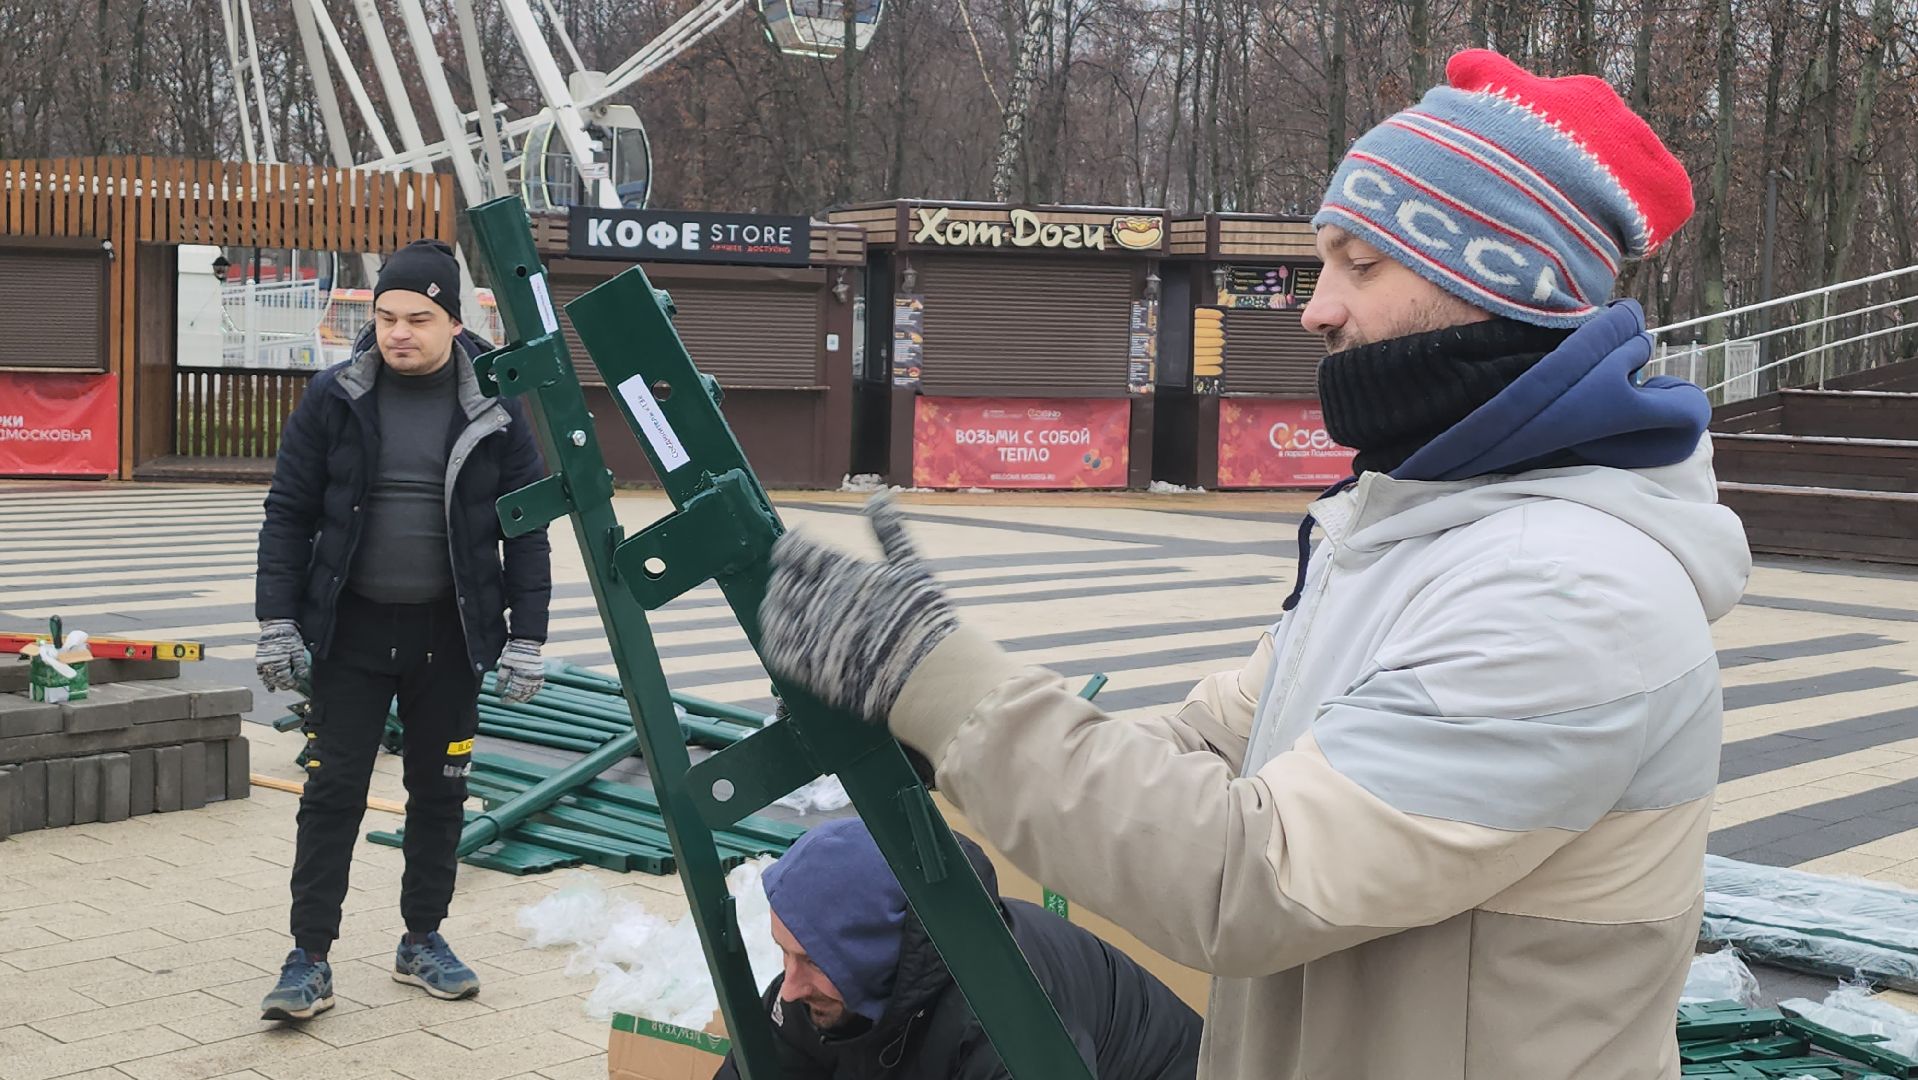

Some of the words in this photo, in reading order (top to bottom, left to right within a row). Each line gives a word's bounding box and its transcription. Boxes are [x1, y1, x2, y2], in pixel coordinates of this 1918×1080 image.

[588, 218, 700, 250] КОФЕ
[710, 223, 792, 245] STORE
[914, 207, 1001, 246] Хот
[1009, 209, 1105, 250] Доги
[0, 415, 24, 428] КИ
[955, 429, 1019, 445] ВОЗЬМИ
[1024, 430, 1034, 445] С
[1039, 427, 1091, 445] СОБОЙ
[1269, 422, 1336, 450] Осе
[997, 447, 1050, 462] ТЕПЛО
